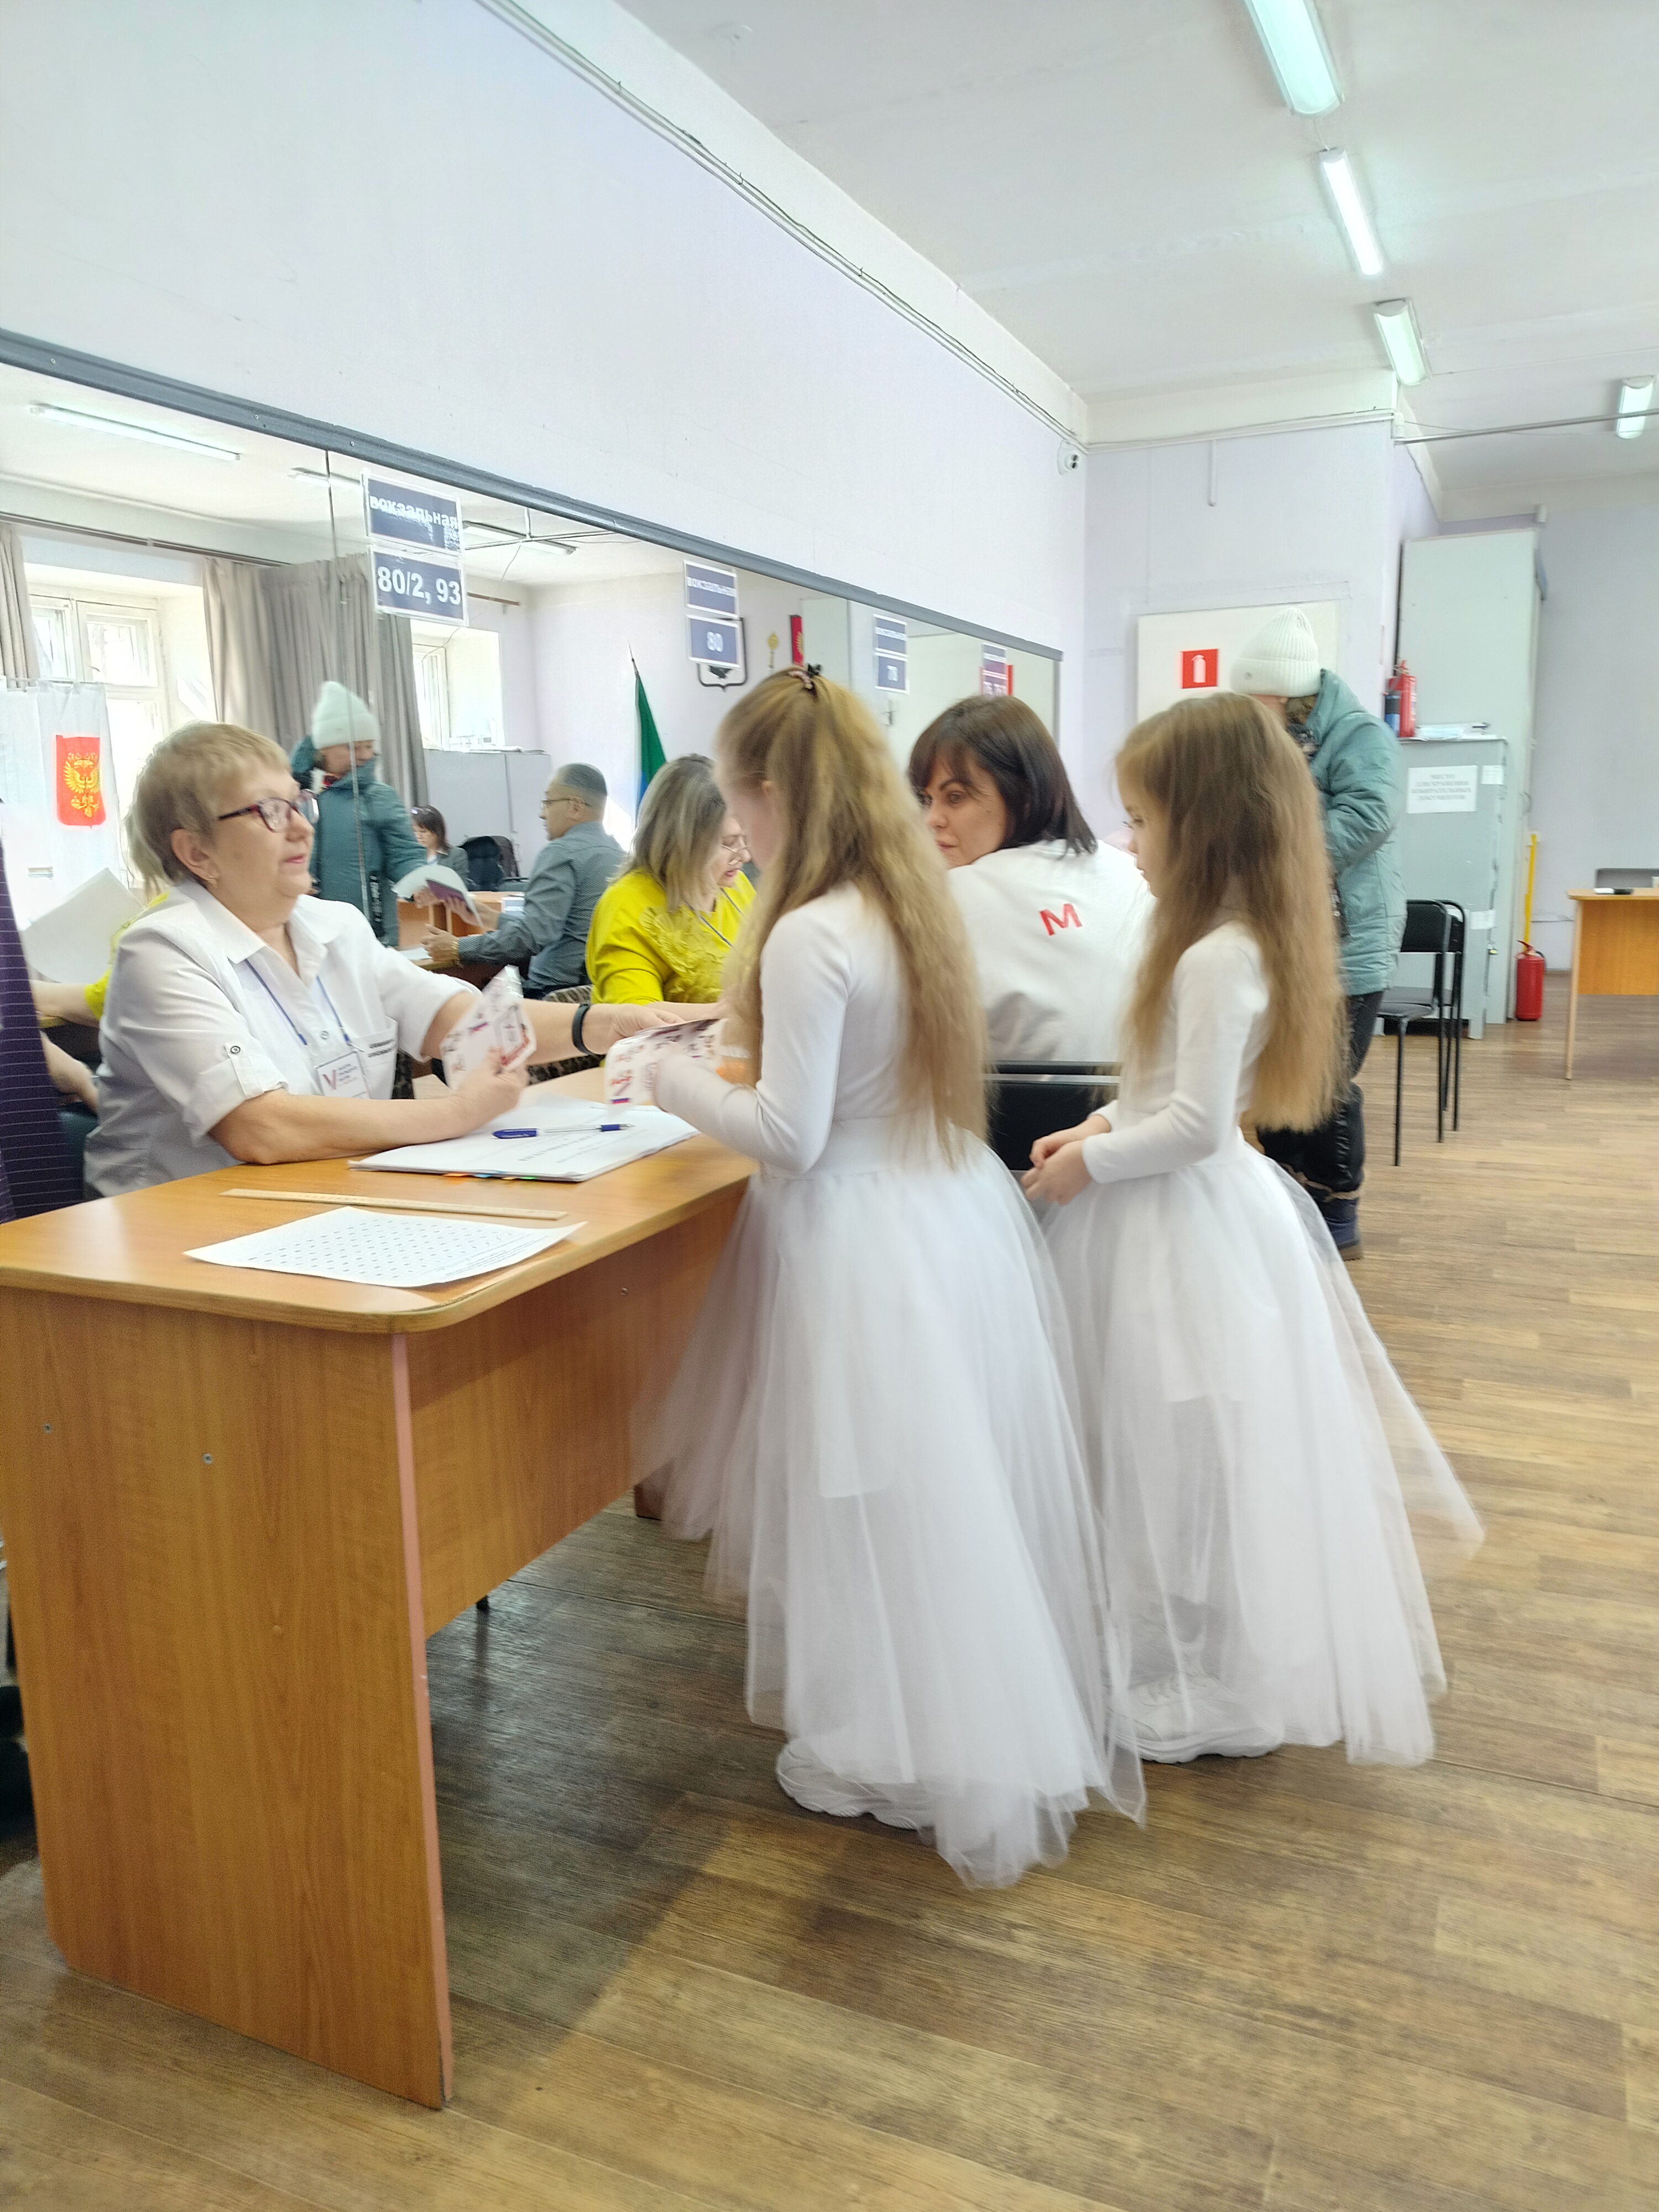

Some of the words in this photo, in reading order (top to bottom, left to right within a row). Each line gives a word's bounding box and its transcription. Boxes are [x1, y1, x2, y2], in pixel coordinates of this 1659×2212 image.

[378, 566, 432, 605] 80/2,
[436, 578, 461, 605] 93
[706, 631, 724, 653] 80
